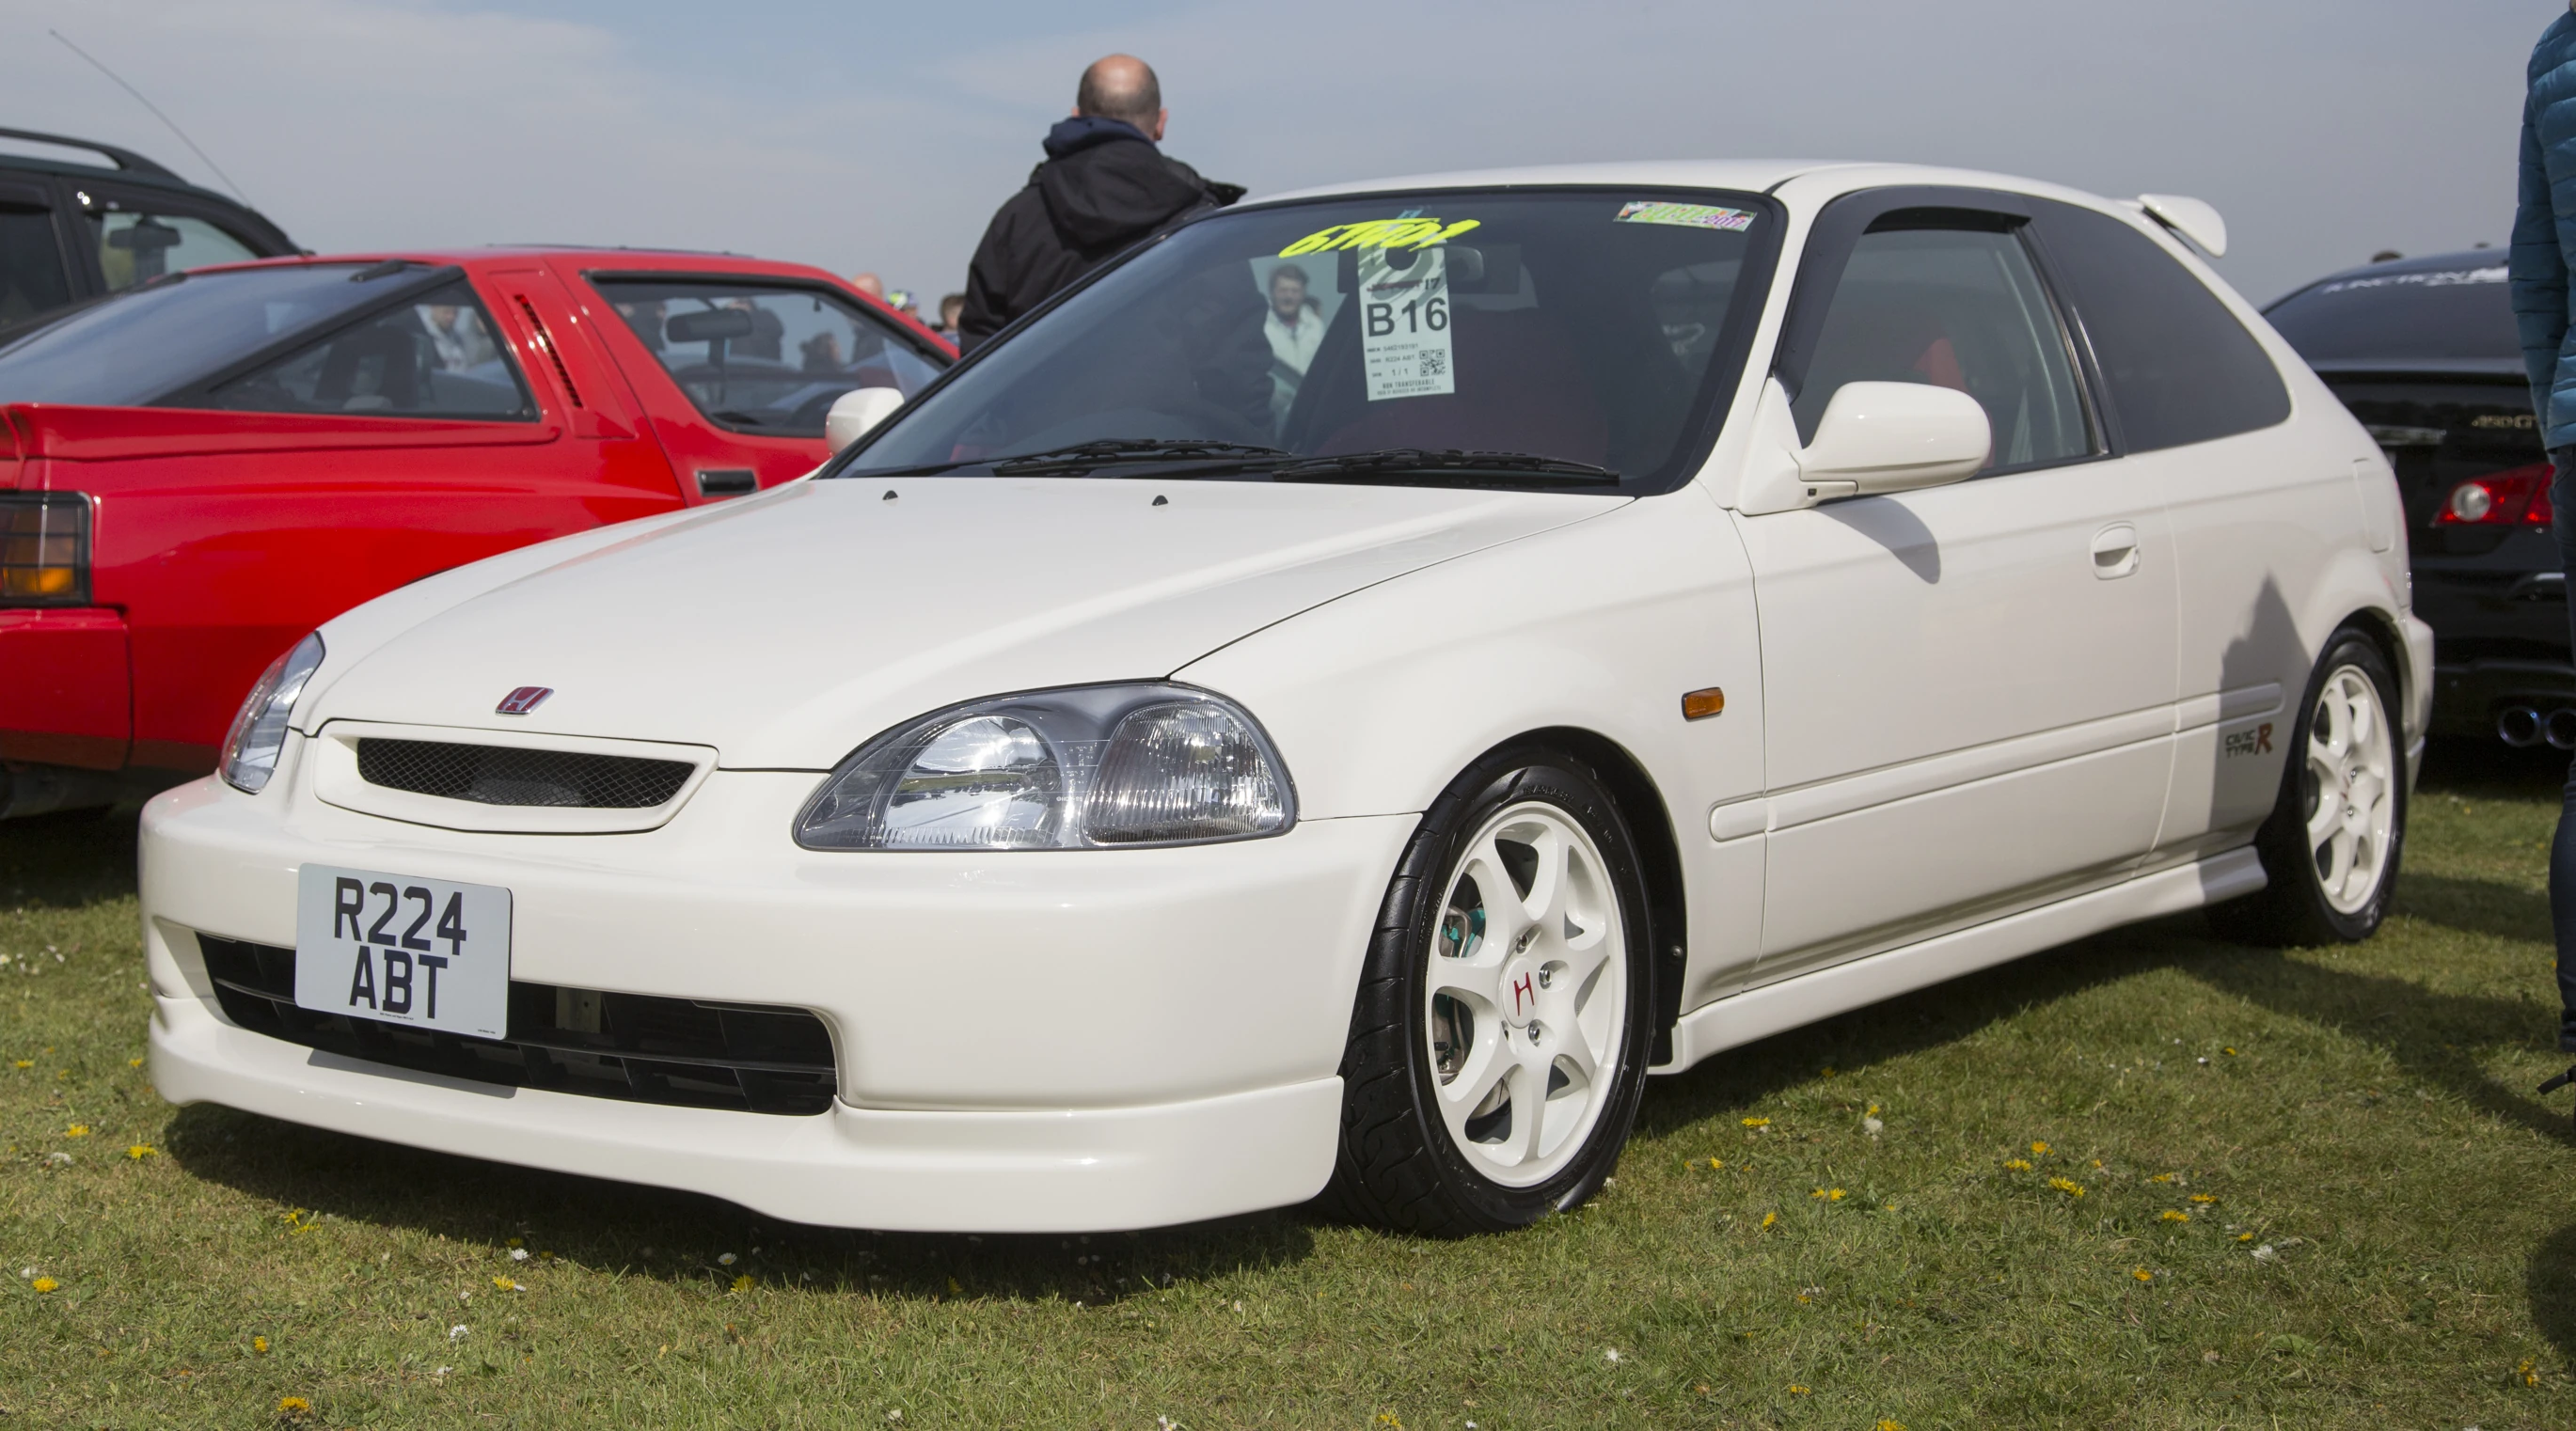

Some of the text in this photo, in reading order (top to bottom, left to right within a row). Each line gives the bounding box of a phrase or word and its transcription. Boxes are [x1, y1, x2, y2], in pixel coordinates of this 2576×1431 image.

[1700, 214, 1746, 228] 2017
[1425, 277, 1441, 290] 17
[1367, 297, 1448, 338] B16
[1395, 379, 1435, 387] TRANSFERABLE
[2254, 722, 2273, 755] R
[335, 876, 467, 956] R224
[349, 945, 448, 1019] ABT
